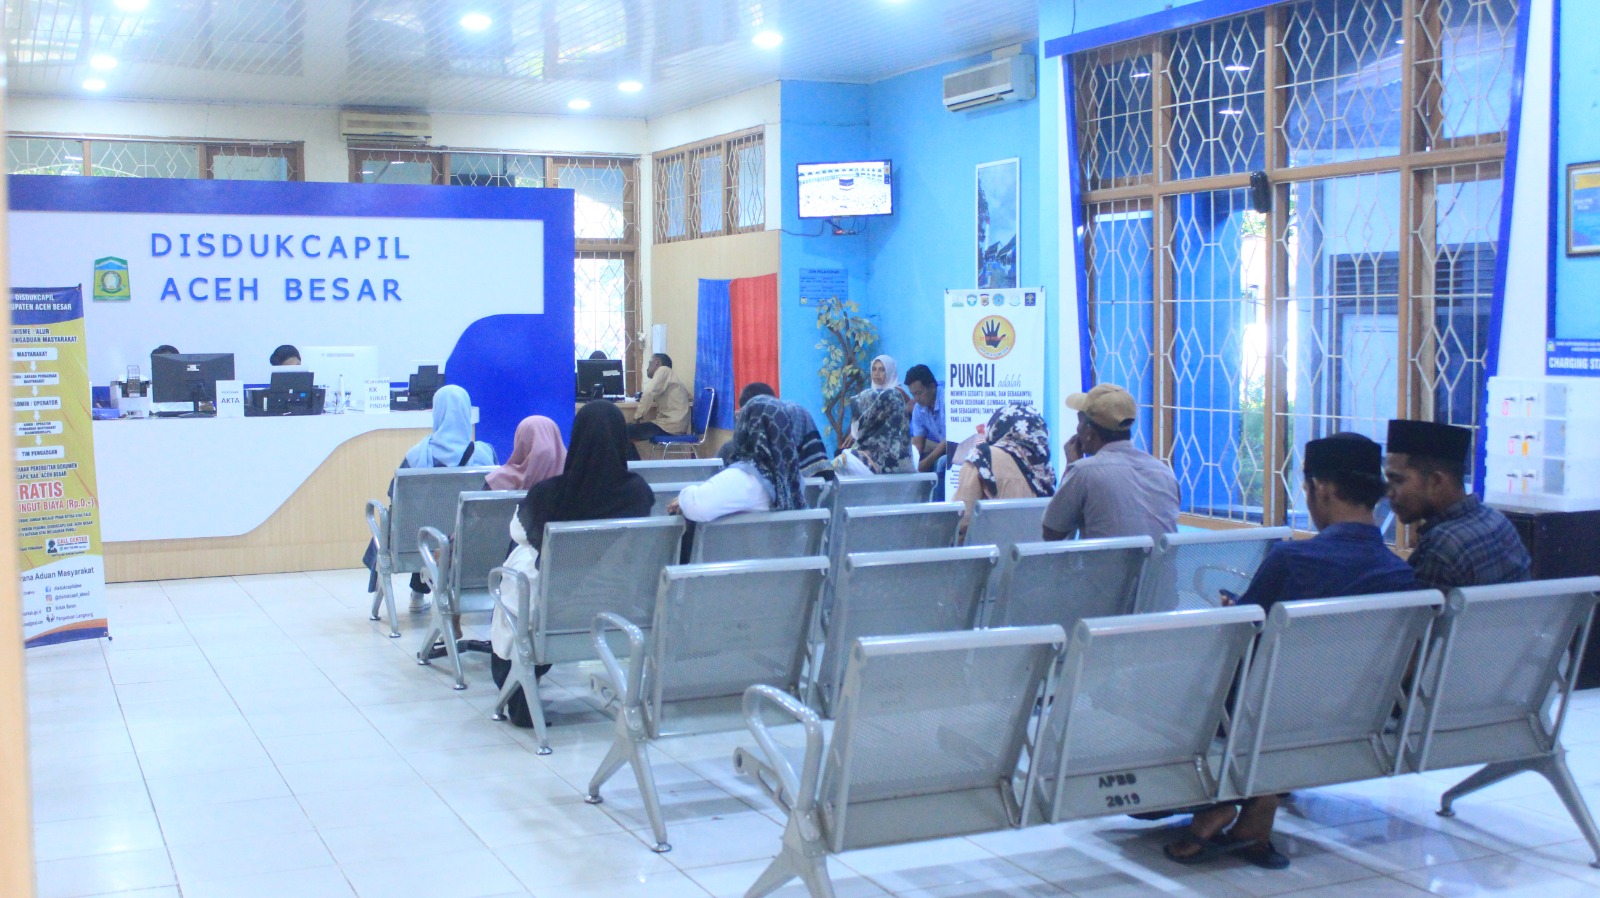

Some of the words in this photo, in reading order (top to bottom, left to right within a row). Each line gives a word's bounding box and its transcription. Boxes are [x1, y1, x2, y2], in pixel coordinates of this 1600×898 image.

[151, 233, 410, 260] DISDUKCAPIL
[160, 277, 258, 302] ACEH
[285, 278, 402, 302] BESAR
[1548, 357, 1588, 369] CHARGING
[950, 364, 994, 388] PUNGLI
[998, 374, 1021, 388] adalah
[18, 481, 63, 500] RATIS
[44, 500, 64, 510] BIAYA
[35, 571, 56, 580] Aduan
[58, 566, 94, 577] Masyarakat
[1105, 792, 1140, 808] 2019
